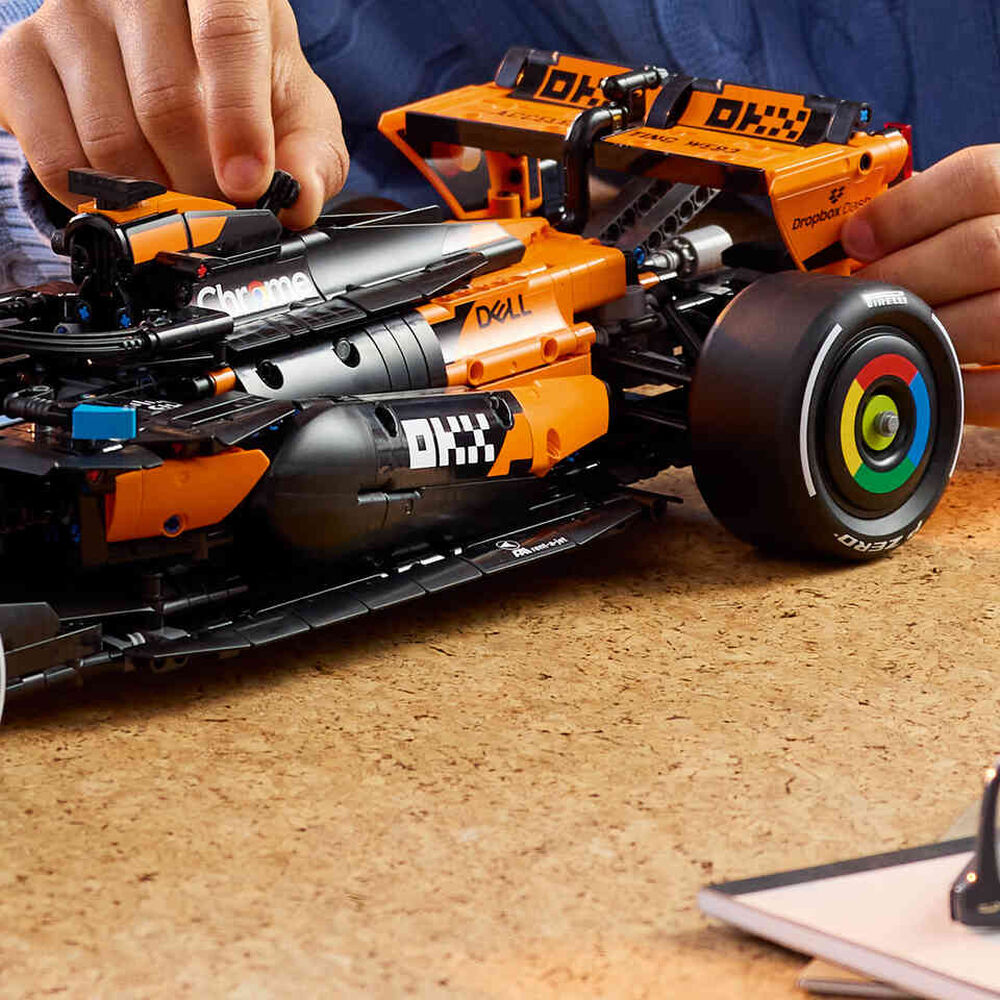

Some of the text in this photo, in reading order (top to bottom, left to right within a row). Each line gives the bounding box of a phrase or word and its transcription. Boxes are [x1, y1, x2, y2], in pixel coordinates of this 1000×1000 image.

[792, 206, 842, 231] Dropbox
[197, 271, 310, 312] Chrome
[475, 294, 532, 328] DELL
[837, 534, 904, 552] ZERO
